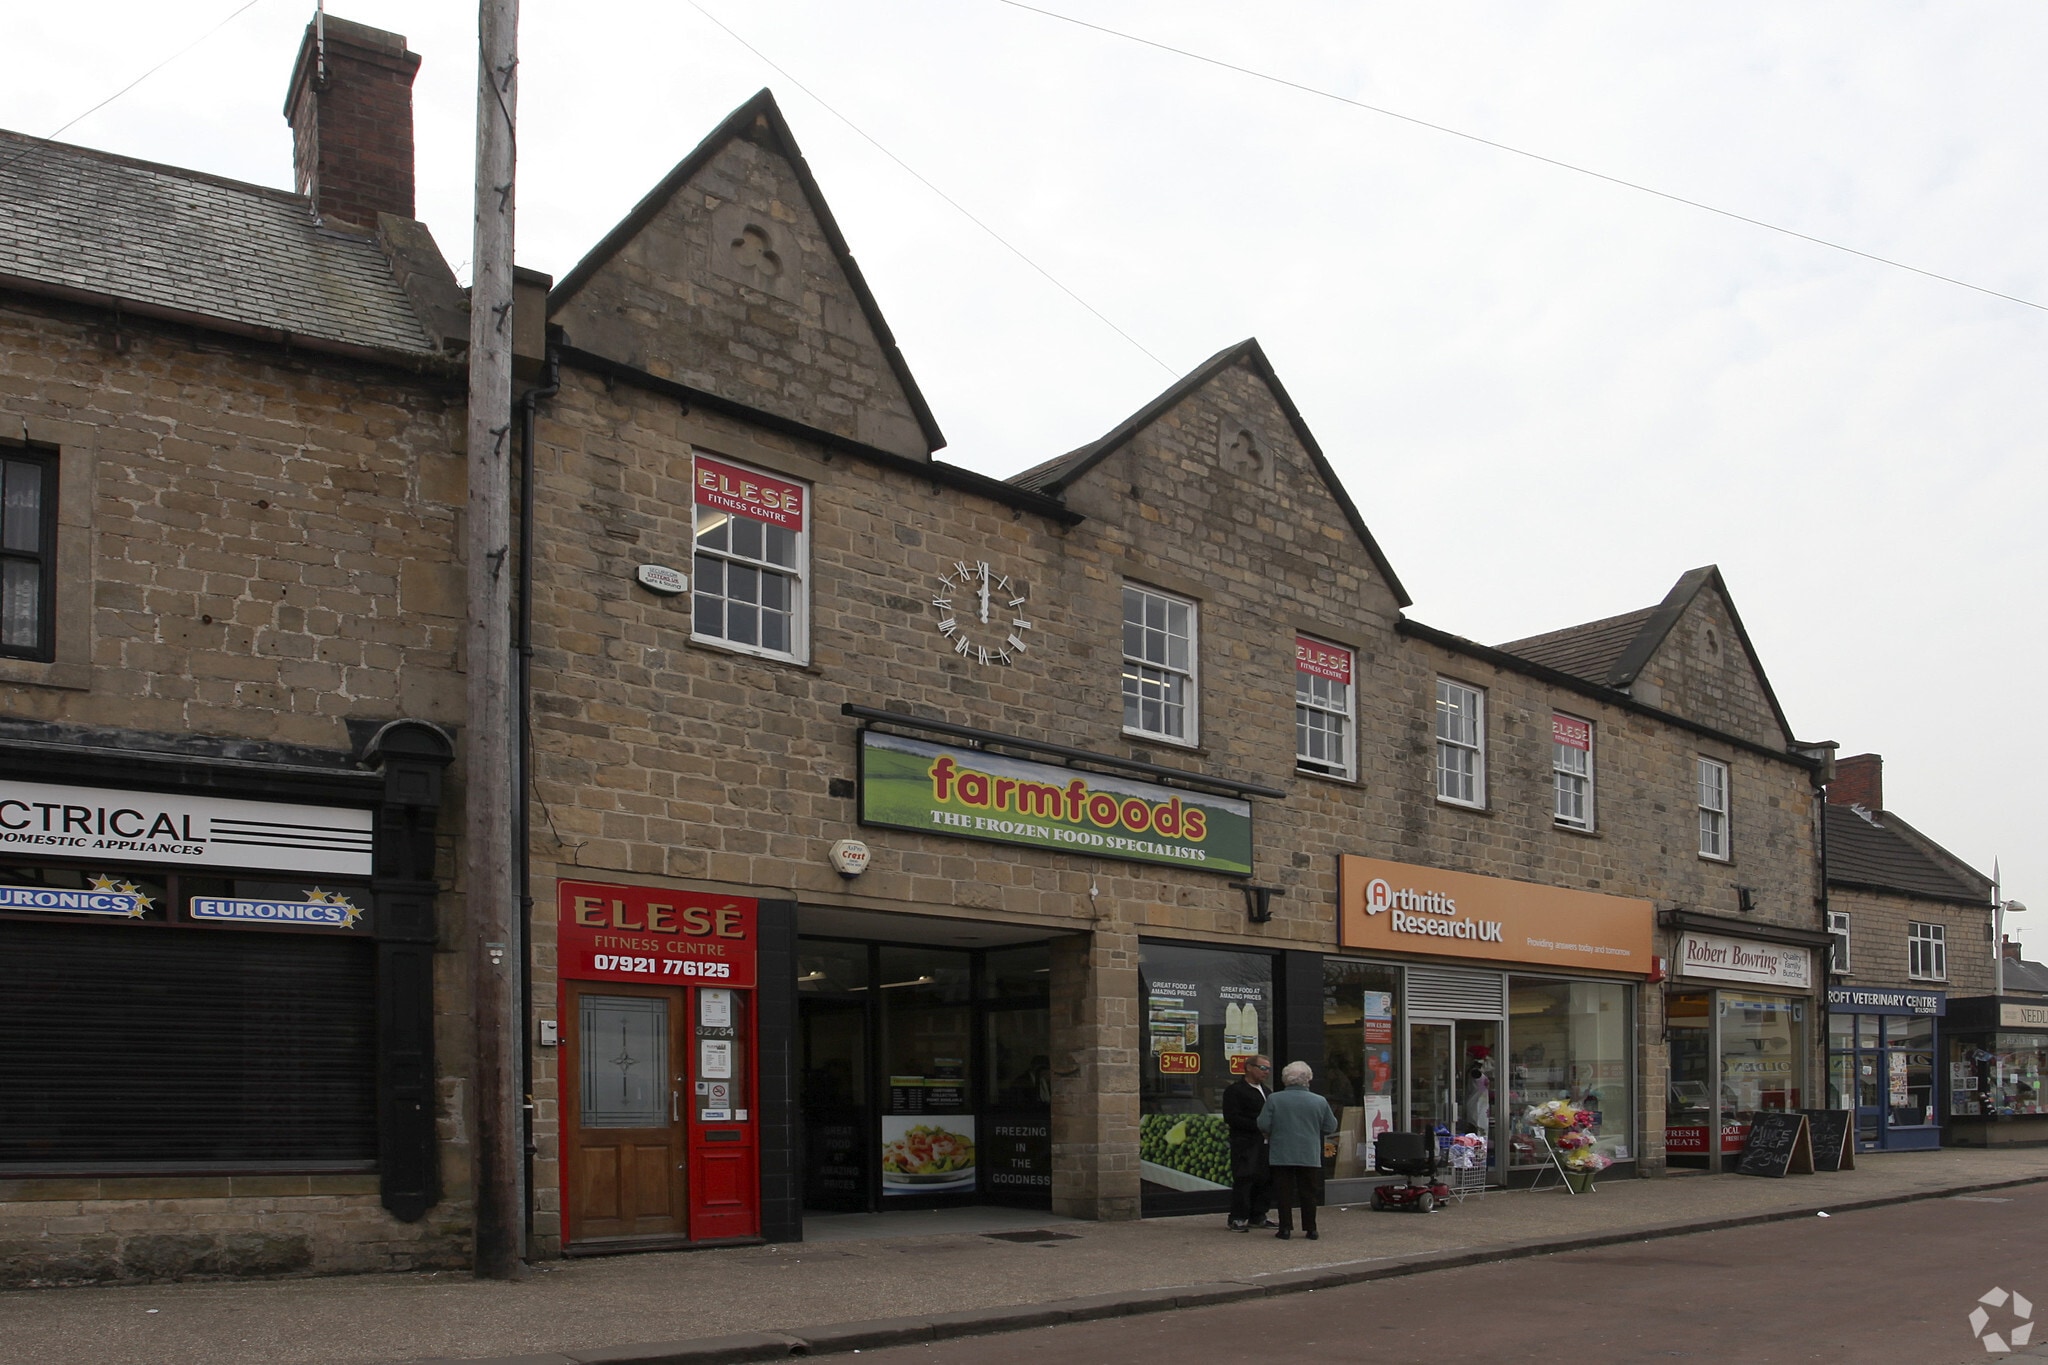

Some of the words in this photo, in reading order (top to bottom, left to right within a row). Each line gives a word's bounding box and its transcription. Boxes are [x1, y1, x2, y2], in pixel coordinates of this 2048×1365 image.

[697, 467, 800, 515] ELESÉ
[708, 494, 747, 511] FITNESS
[750, 506, 787, 523] CENTRE
[1296, 644, 1349, 673] ELESÉ
[1300, 662, 1321, 673] FITNESS
[1322, 668, 1343, 679] CENTRE
[1552, 721, 1589, 742] ELESÉ
[928, 754, 1207, 842] farmfoods
[0, 800, 207, 843] CTRICAL
[930, 810, 971, 828] THE
[975, 816, 1050, 839] FROZEN
[1053, 828, 1103, 846] FOOD
[1106, 836, 1206, 861] SPECIALISTS
[92, 839, 204, 855] APPLIANCES
[842, 850, 865, 860] Crest
[1366, 878, 1456, 916] Arthritis
[200, 901, 341, 921] EURONICS
[574, 895, 747, 940] ELESÉ
[1391, 909, 1476, 939] Research
[1477, 919, 1503, 942] UK
[594, 935, 659, 951] FITNESS
[666, 941, 726, 956] CENTRE
[1527, 937, 1554, 950] Providing
[1555, 942, 1577, 951] answers
[1578, 944, 1593, 954] today
[1594, 946, 1605, 954] and
[1605, 947, 1631, 956] tomorrow
[1687, 939, 1727, 963] Robert
[1732, 945, 1777, 975] Bowring
[1782, 952, 1801, 962] Quality
[594, 954, 656, 973] 07921
[663, 959, 730, 978] 776125
[1782, 969, 1803, 979] Butcher
[1784, 961, 1801, 971] Family
[1151, 988, 1176, 996] AMAZING
[1177, 989, 1197, 997] PRICES
[1152, 981, 1171, 989] GREAT
[1172, 982, 1188, 990] FOOD
[1243, 993, 1261, 1001] PRICES
[1852, 992, 1904, 1007] VETERINARY
[1906, 995, 1937, 1008] CENTRE
[2021, 1008, 2048, 1024] NEEDL
[696, 1026, 734, 1037] 32/34
[1163, 1055, 1171, 1068] 3
[1231, 1056, 1238, 1069] 2
[995, 1126, 1047, 1137] FREEZING
[1665, 1129, 1699, 1137] FRESH
[1750, 1124, 1793, 1140] MINCE
[1015, 1143, 1026, 1152] IN
[1664, 1138, 1700, 1146] MEATS
[1750, 1137, 1789, 1149] BEEF
[1010, 1158, 1031, 1168] THE
[992, 1173, 1051, 1185] GOODNESS
